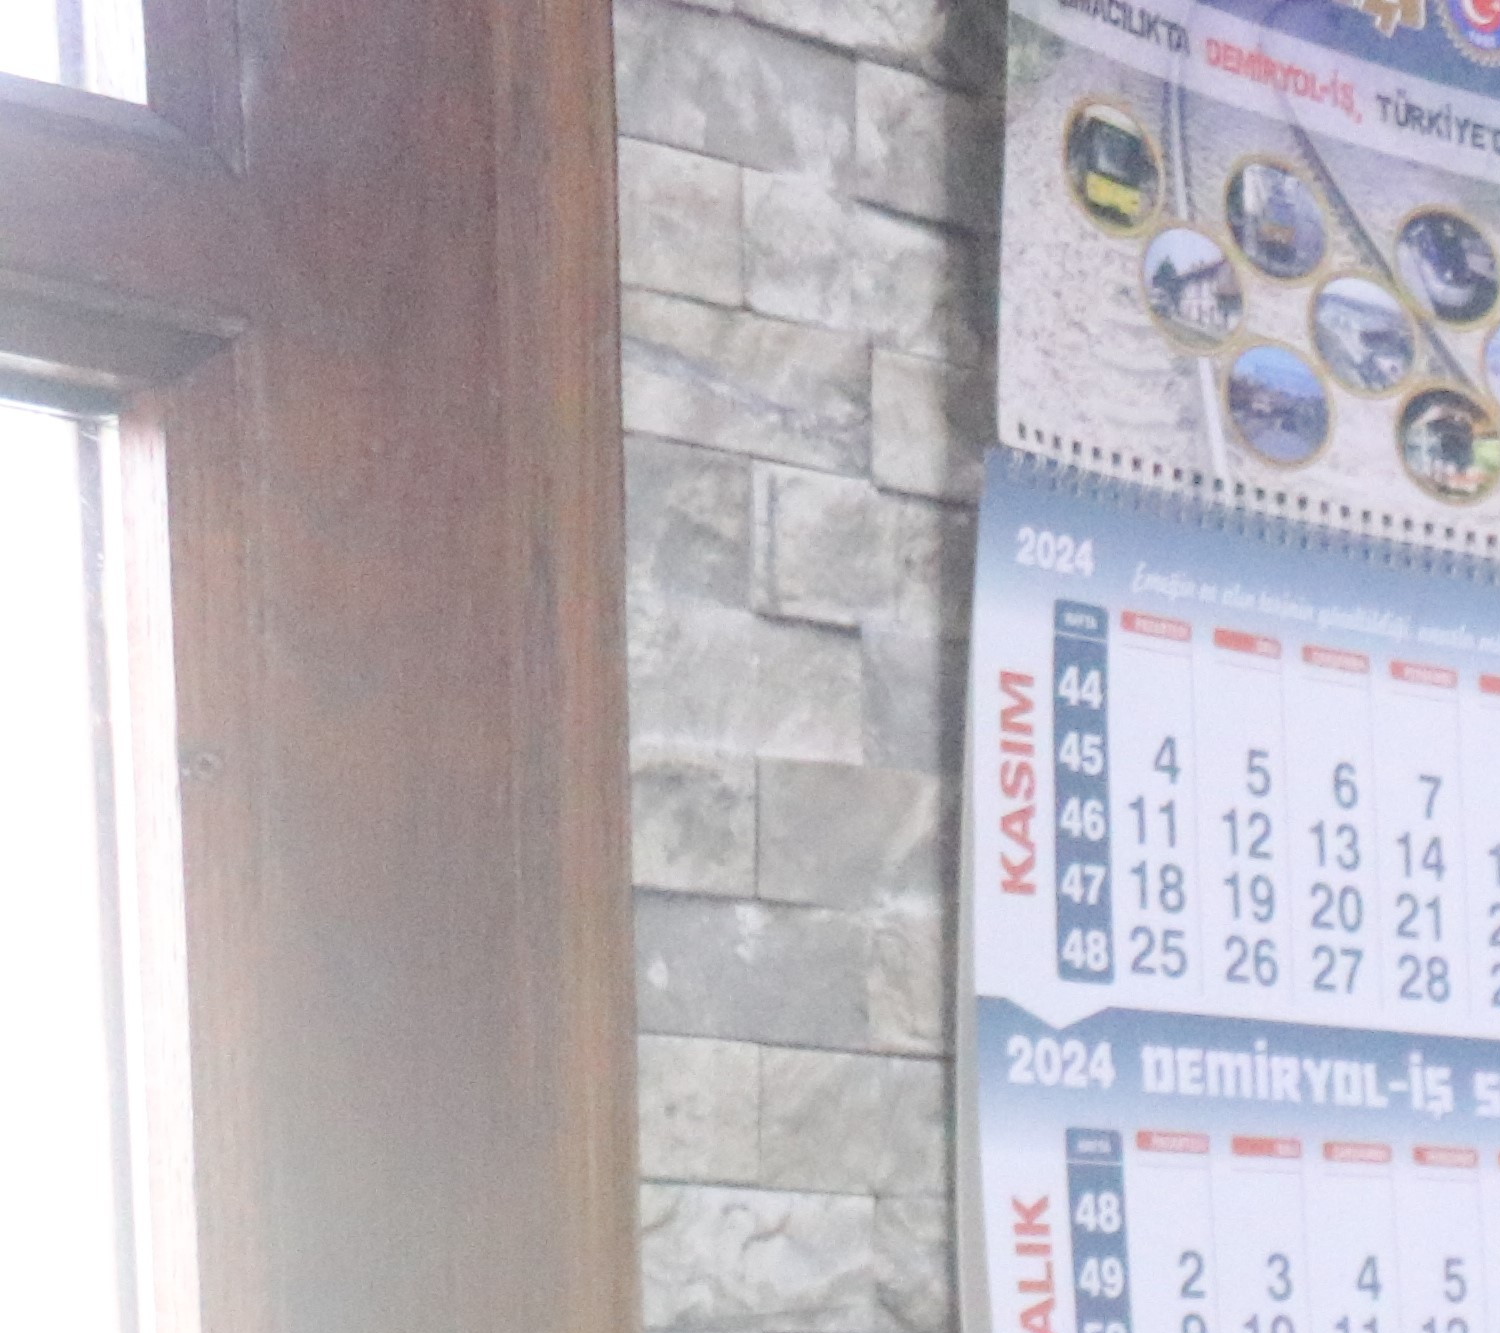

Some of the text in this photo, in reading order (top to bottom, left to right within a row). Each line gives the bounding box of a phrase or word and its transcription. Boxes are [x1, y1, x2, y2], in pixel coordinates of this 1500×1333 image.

[1015, 522, 1094, 582] 2024
[1059, 667, 1102, 708] 44
[999, 671, 1035, 895] KASIM
[1060, 732, 1103, 775] 45
[1154, 736, 1180, 783] 4
[1247, 749, 1271, 797] 5
[1333, 762, 1358, 809] 6
[1419, 774, 1442, 819] 7
[1057, 791, 1104, 840] 46
[1129, 796, 1176, 847] 11
[1222, 808, 1271, 859] 12
[1310, 820, 1360, 871] 13
[1397, 832, 1445, 880] 14
[1056, 857, 1109, 912] 47
[1131, 861, 1185, 913] 18
[1224, 872, 1275, 923] 19
[1310, 882, 1363, 933] 20
[1396, 892, 1441, 940] 21
[1063, 929, 1108, 970] 48
[1130, 925, 1187, 978] 25
[1225, 935, 1278, 987] 26
[1313, 944, 1363, 993] 27
[1398, 953, 1450, 1003] 28
[1007, 1035, 1115, 1090] 2024
[1142, 1039, 1454, 1117] DEMİRYOL-İŞ
[1075, 1192, 1121, 1233] 48
[1079, 1257, 1124, 1298] 49
[1179, 1250, 1204, 1299] 2
[1267, 1253, 1292, 1301] 3
[1357, 1256, 1381, 1299] 4
[1444, 1257, 1467, 1303] 5
